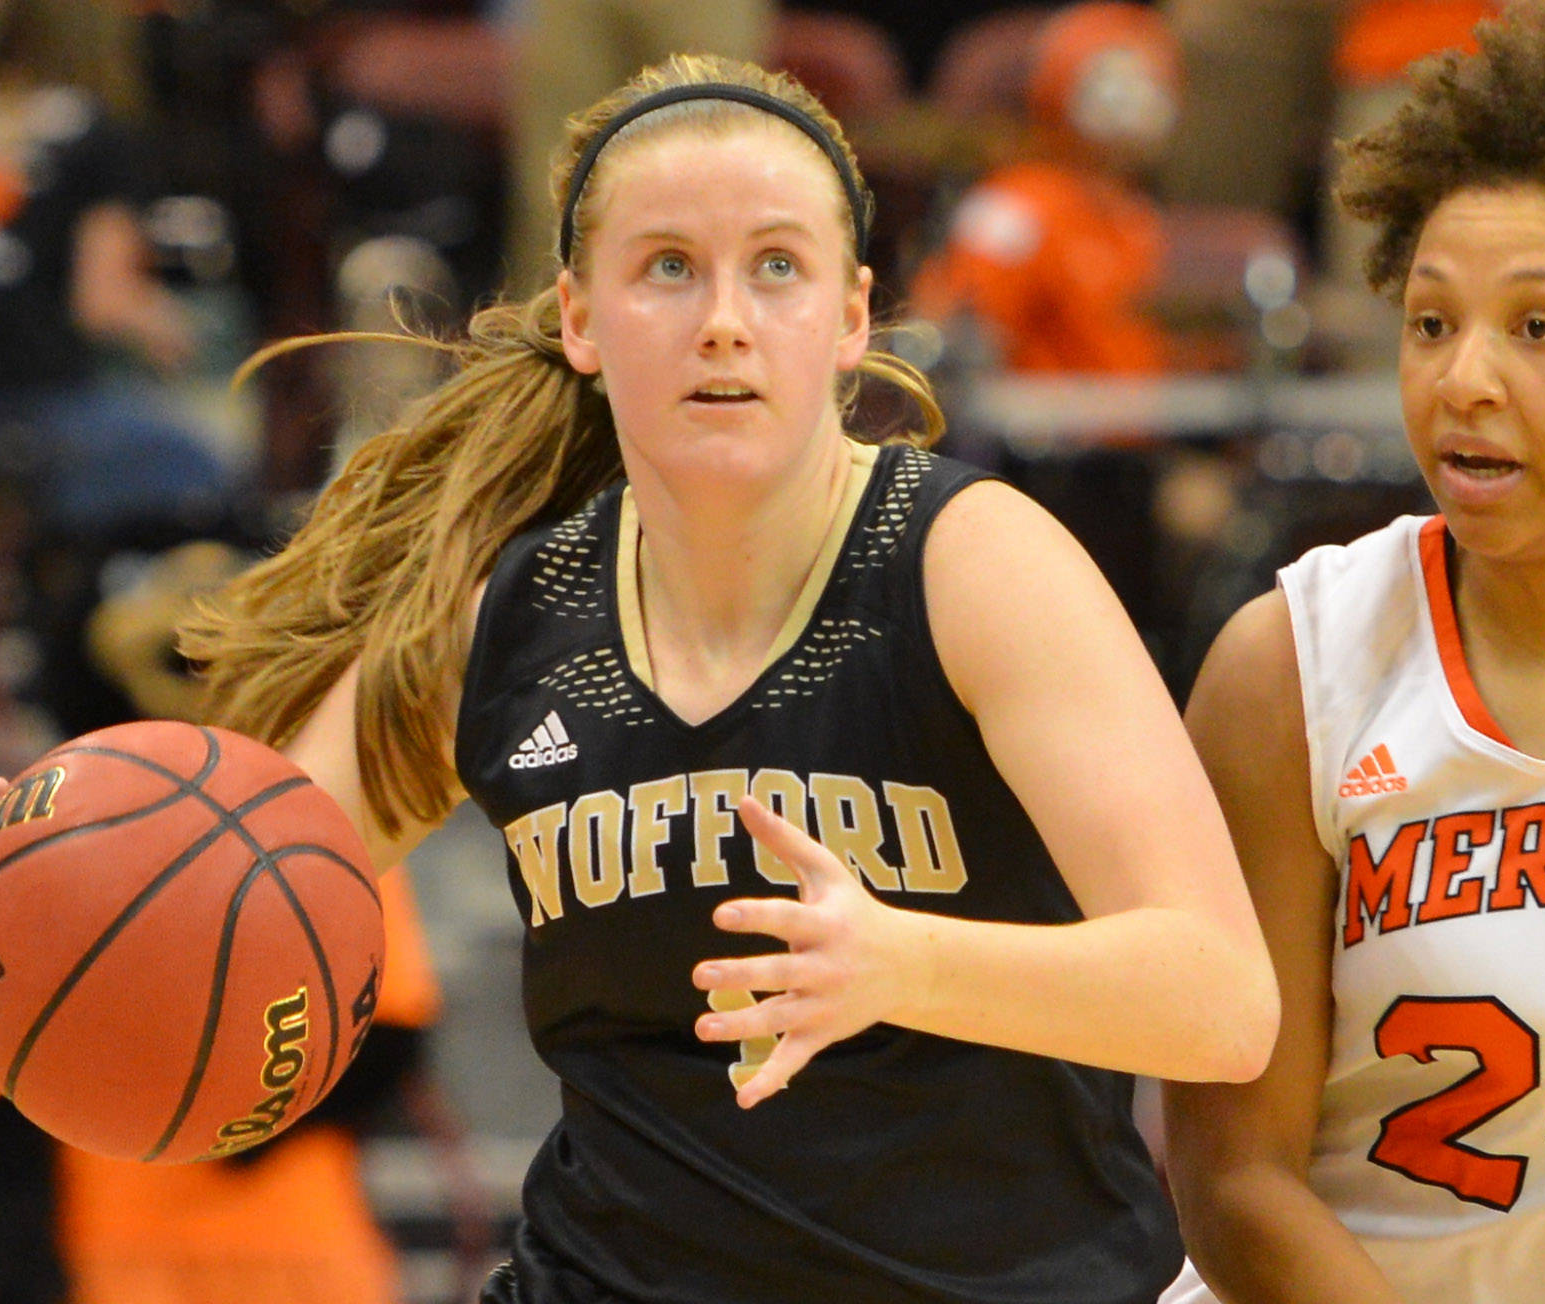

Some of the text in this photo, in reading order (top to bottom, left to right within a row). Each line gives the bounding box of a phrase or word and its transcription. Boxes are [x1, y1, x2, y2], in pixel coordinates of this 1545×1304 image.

[508, 743, 579, 770] adidas
[1338, 776, 1409, 798] adidas
[503, 768, 969, 928] WOFFORD
